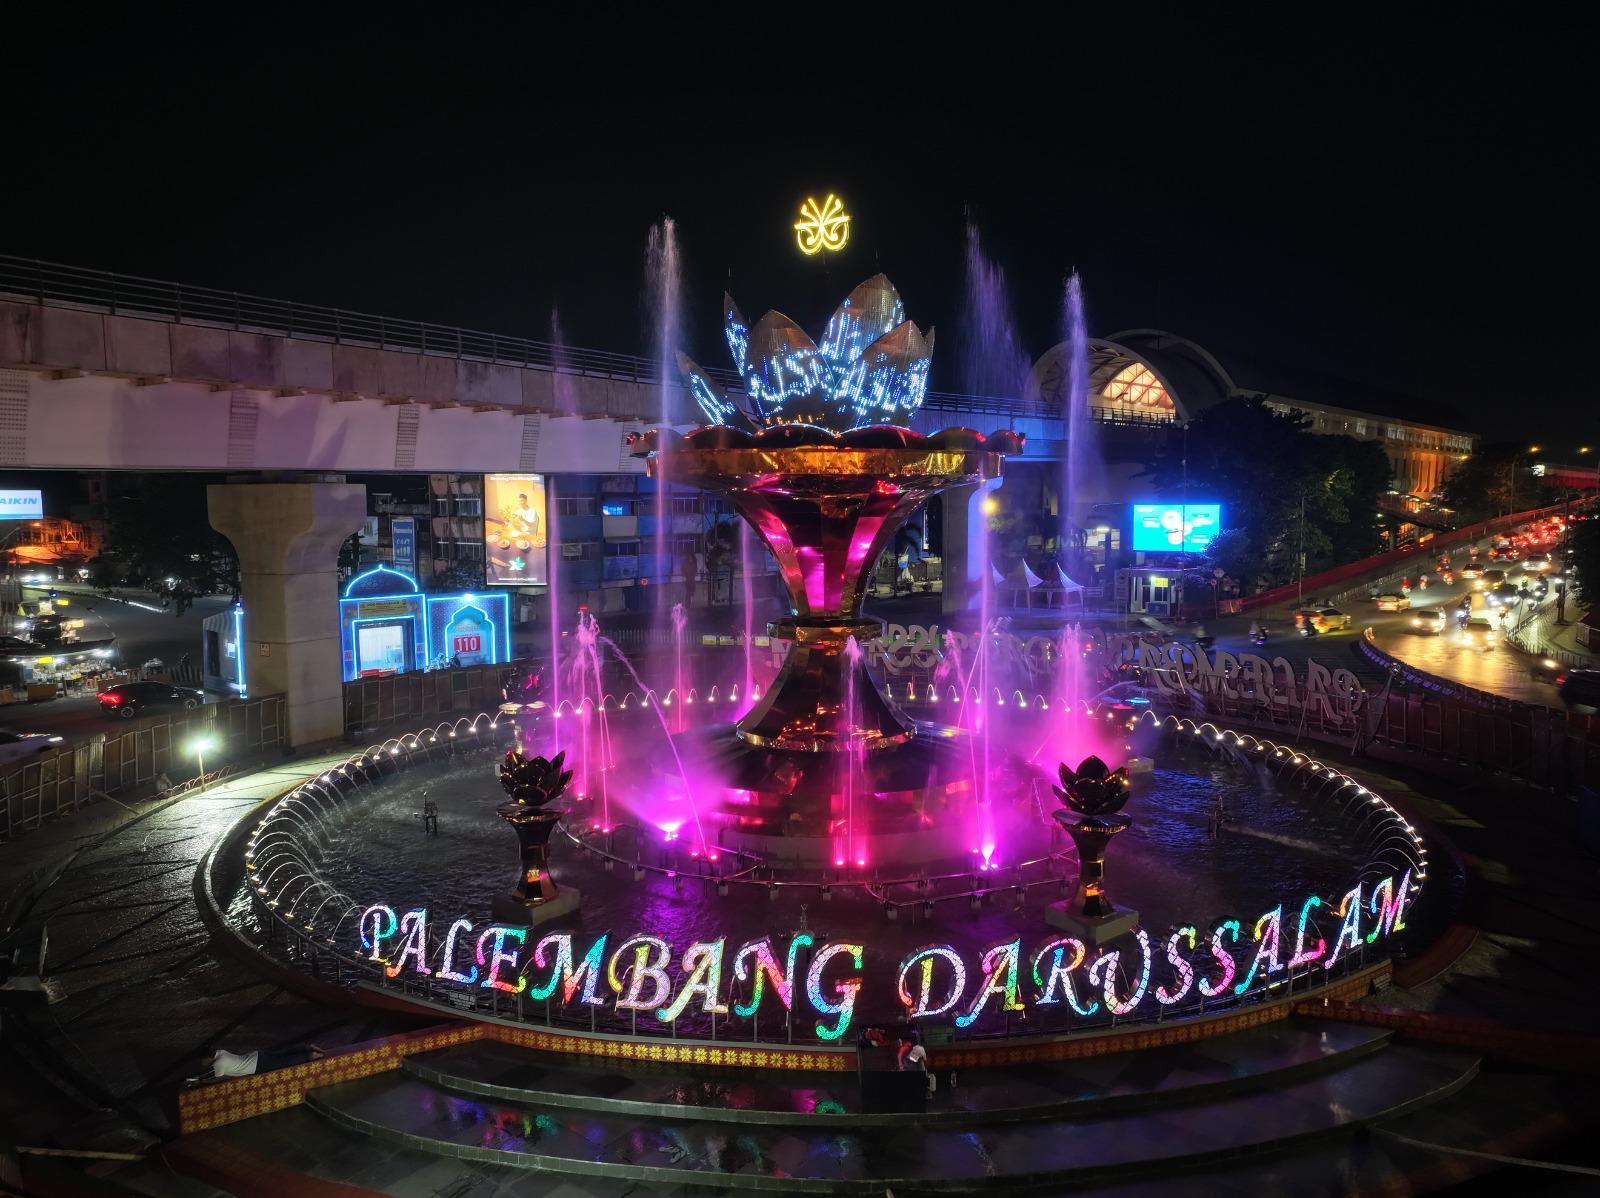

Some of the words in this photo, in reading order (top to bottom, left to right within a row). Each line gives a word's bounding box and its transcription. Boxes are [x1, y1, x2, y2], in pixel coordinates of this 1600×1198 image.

[457, 637, 477, 652] 110
[359, 902, 864, 1041] PALEMBANG
[897, 866, 1413, 1028] DARUSSALAM
